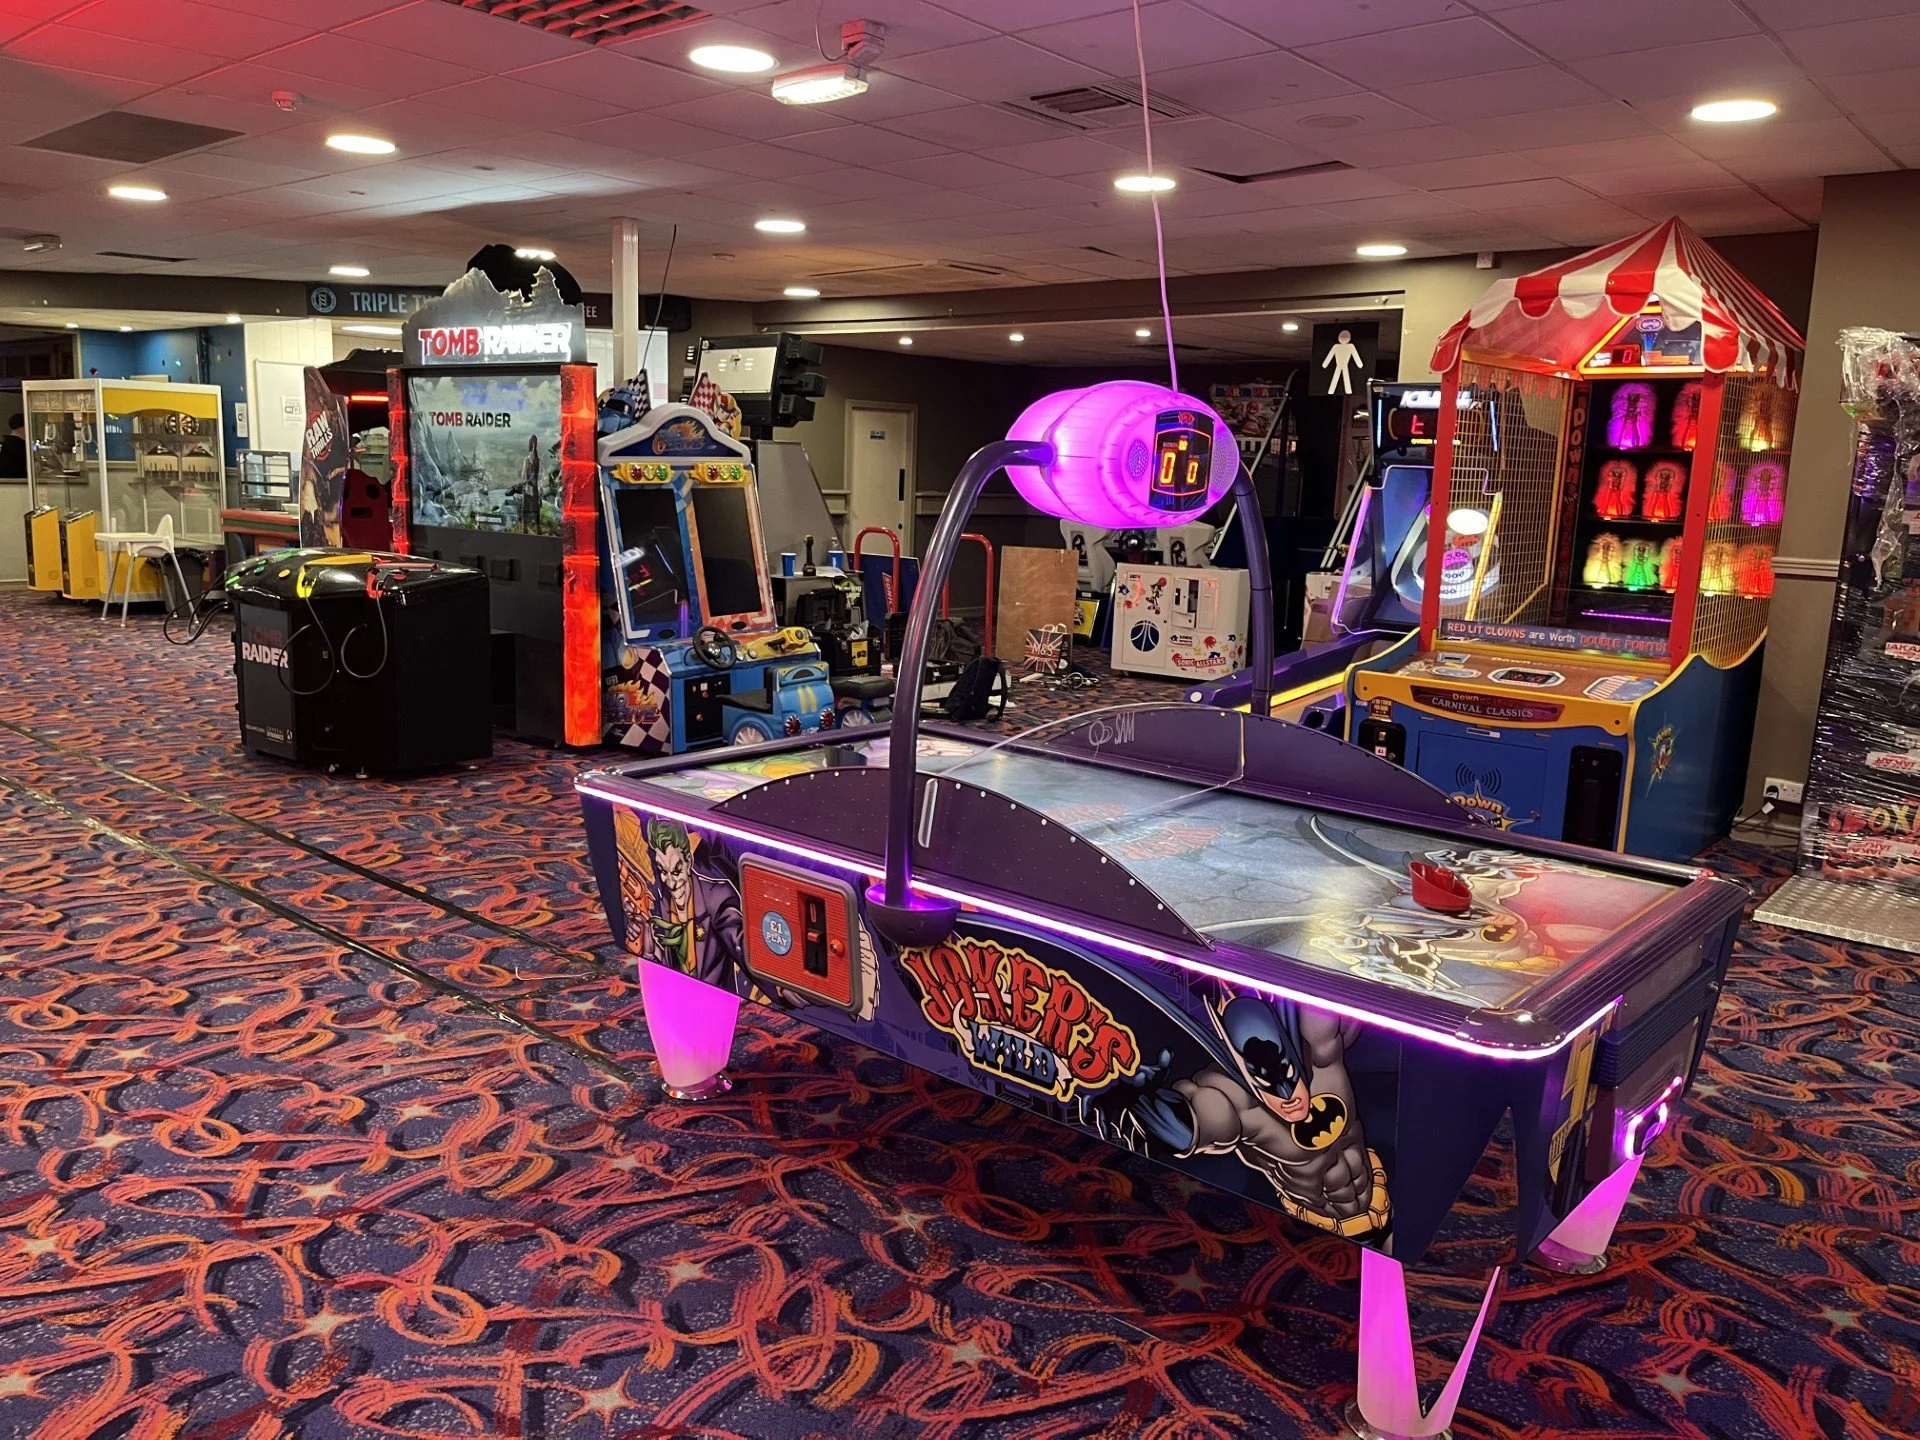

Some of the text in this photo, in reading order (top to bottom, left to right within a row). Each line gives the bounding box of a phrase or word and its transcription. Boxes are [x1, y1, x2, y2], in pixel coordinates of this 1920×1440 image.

[350, 291, 408, 314] TRIPLE
[419, 322, 572, 357] TOMB RAIDER
[428, 411, 512, 428] TOMB RAIDER
[1160, 451, 1177, 484] 0
[1186, 461, 1199, 484] 0
[1447, 622, 1467, 633] RED
[1467, 624, 1484, 635] LIT
[1485, 626, 1526, 639] CLOWNS
[1528, 631, 1546, 641] are
[1549, 632, 1576, 644] Worth
[1579, 635, 1622, 648] DOUBLE
[241, 641, 289, 668] RAIDER
[1031, 644, 1054, 657] M&S
[1431, 696, 1482, 715] CARNIVAL
[1486, 706, 1534, 719] CLASSICS
[769, 919, 783, 935] £1
[765, 931, 788, 947] PLAY
